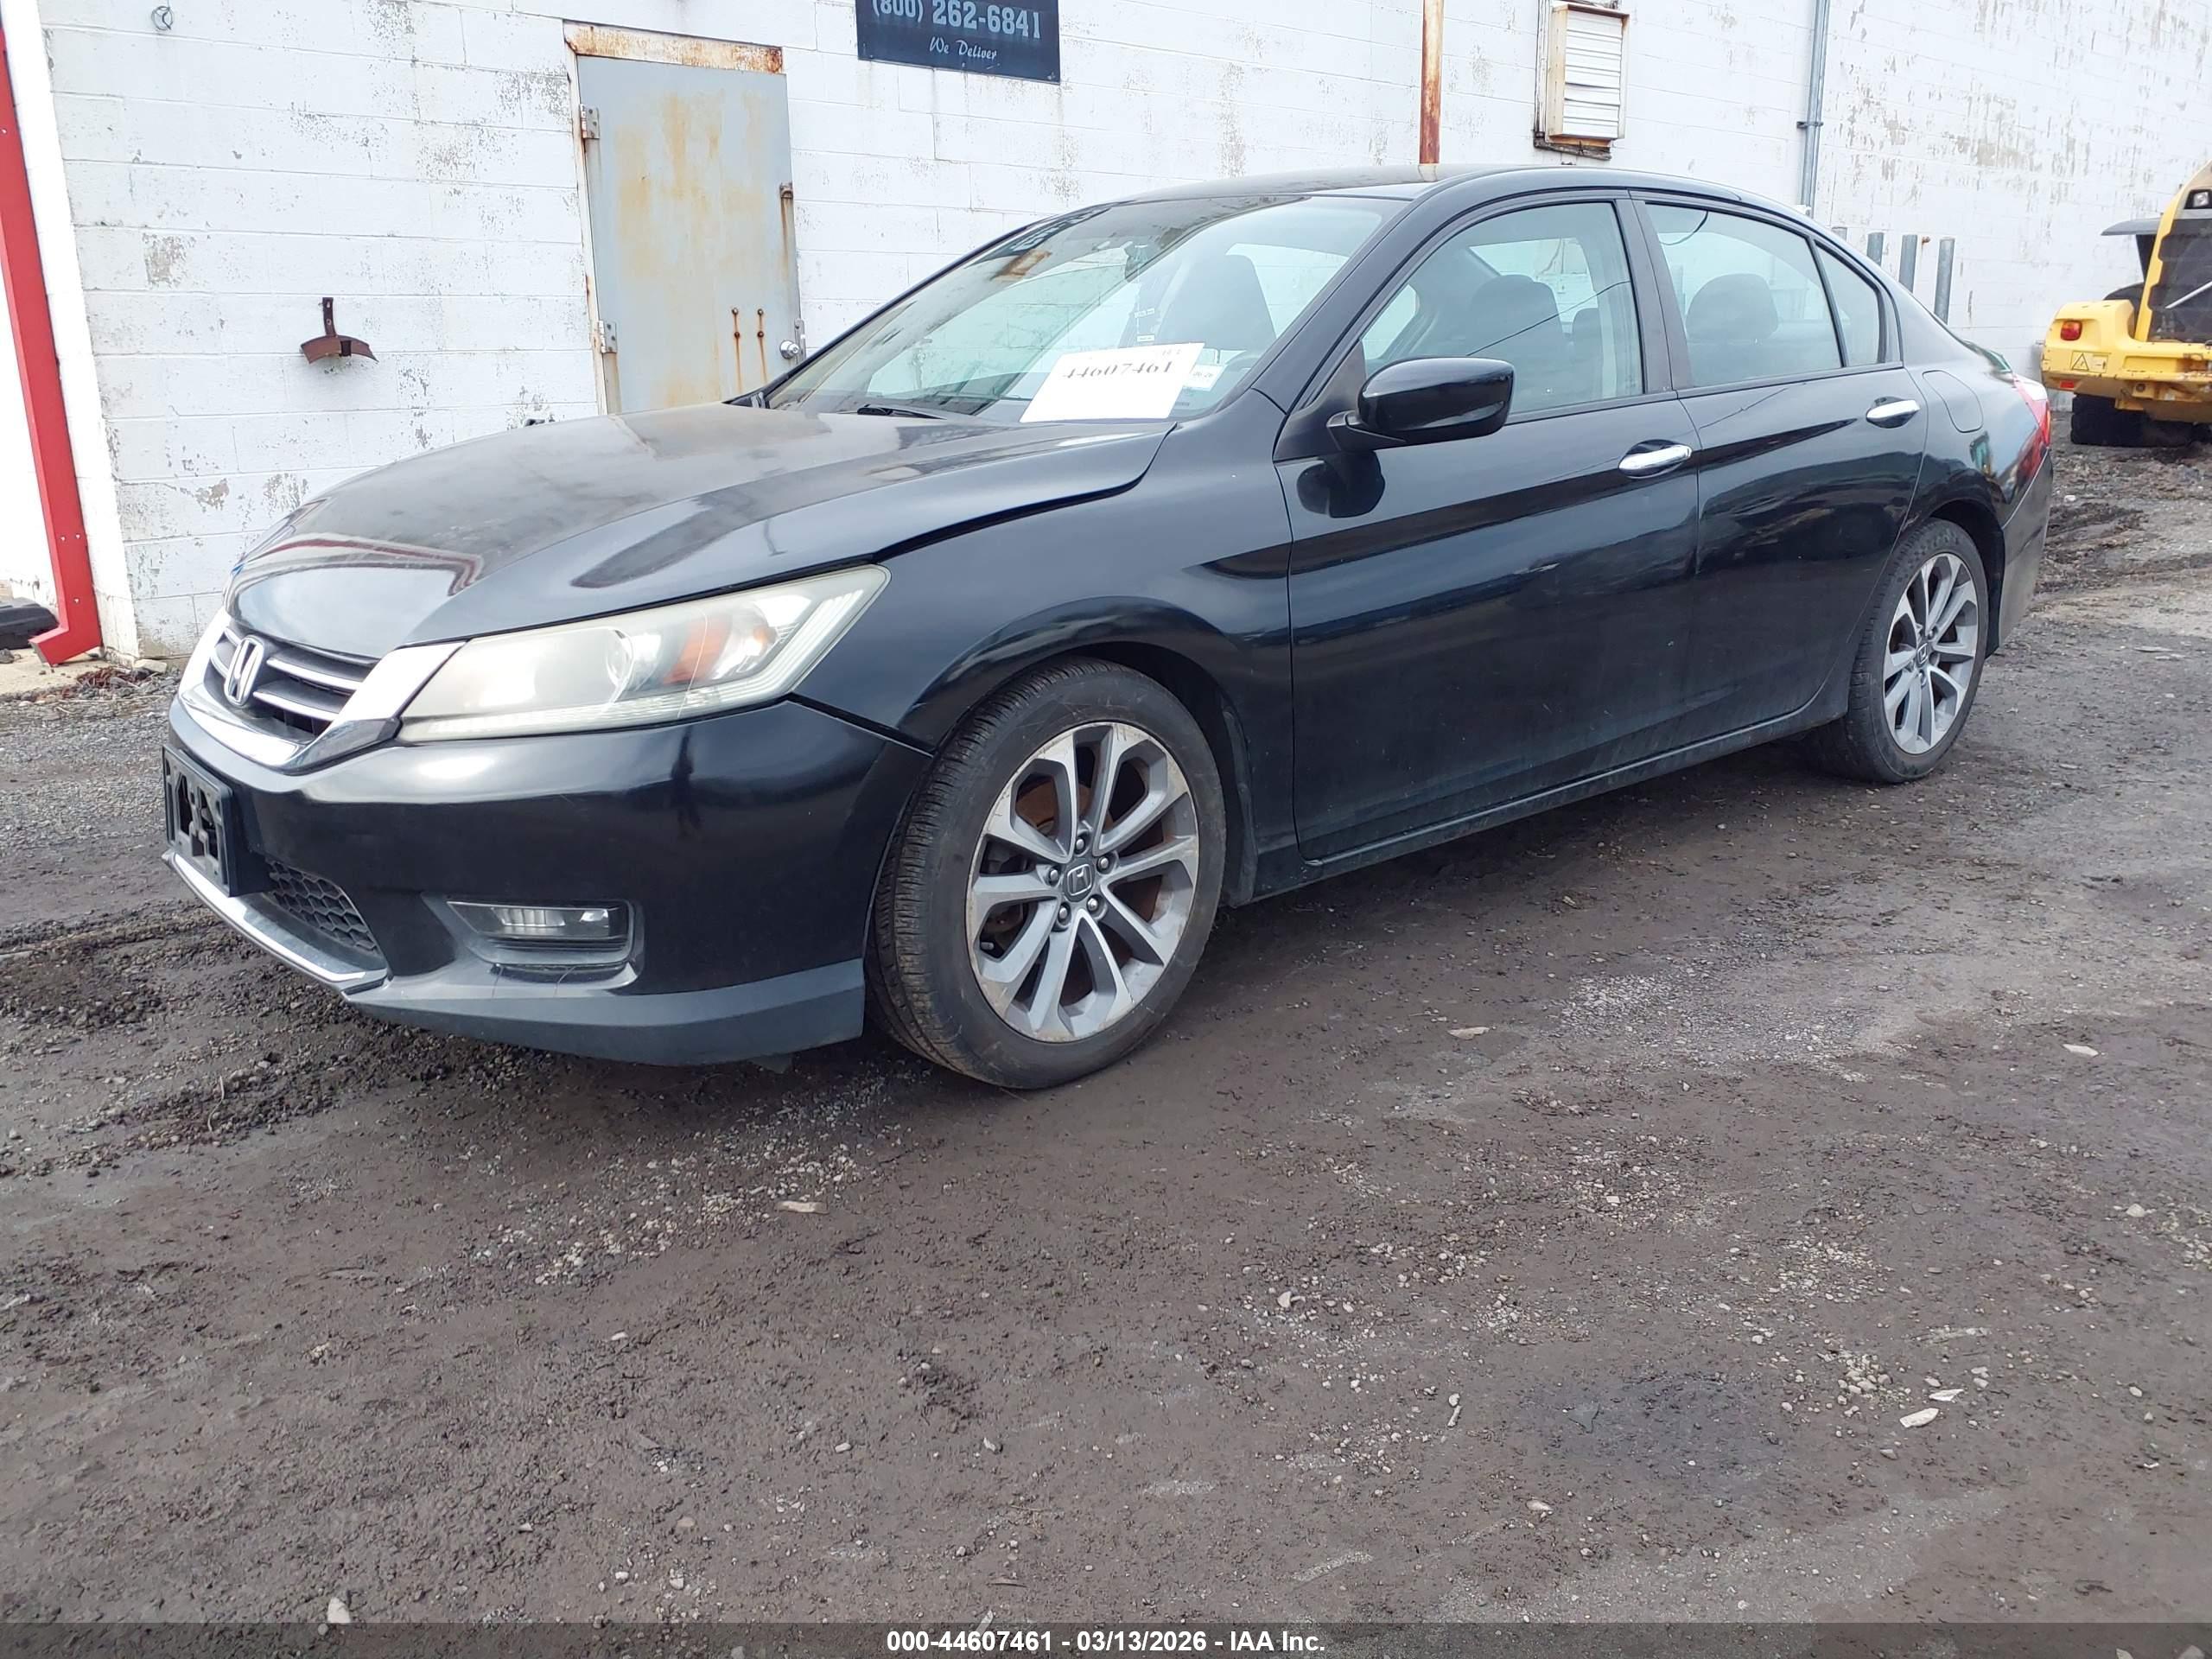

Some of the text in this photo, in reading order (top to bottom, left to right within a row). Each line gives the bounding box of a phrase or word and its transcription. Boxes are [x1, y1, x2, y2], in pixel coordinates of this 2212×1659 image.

[932, 0, 1041, 39] 262-6841
[929, 36, 998, 60] We Deliver
